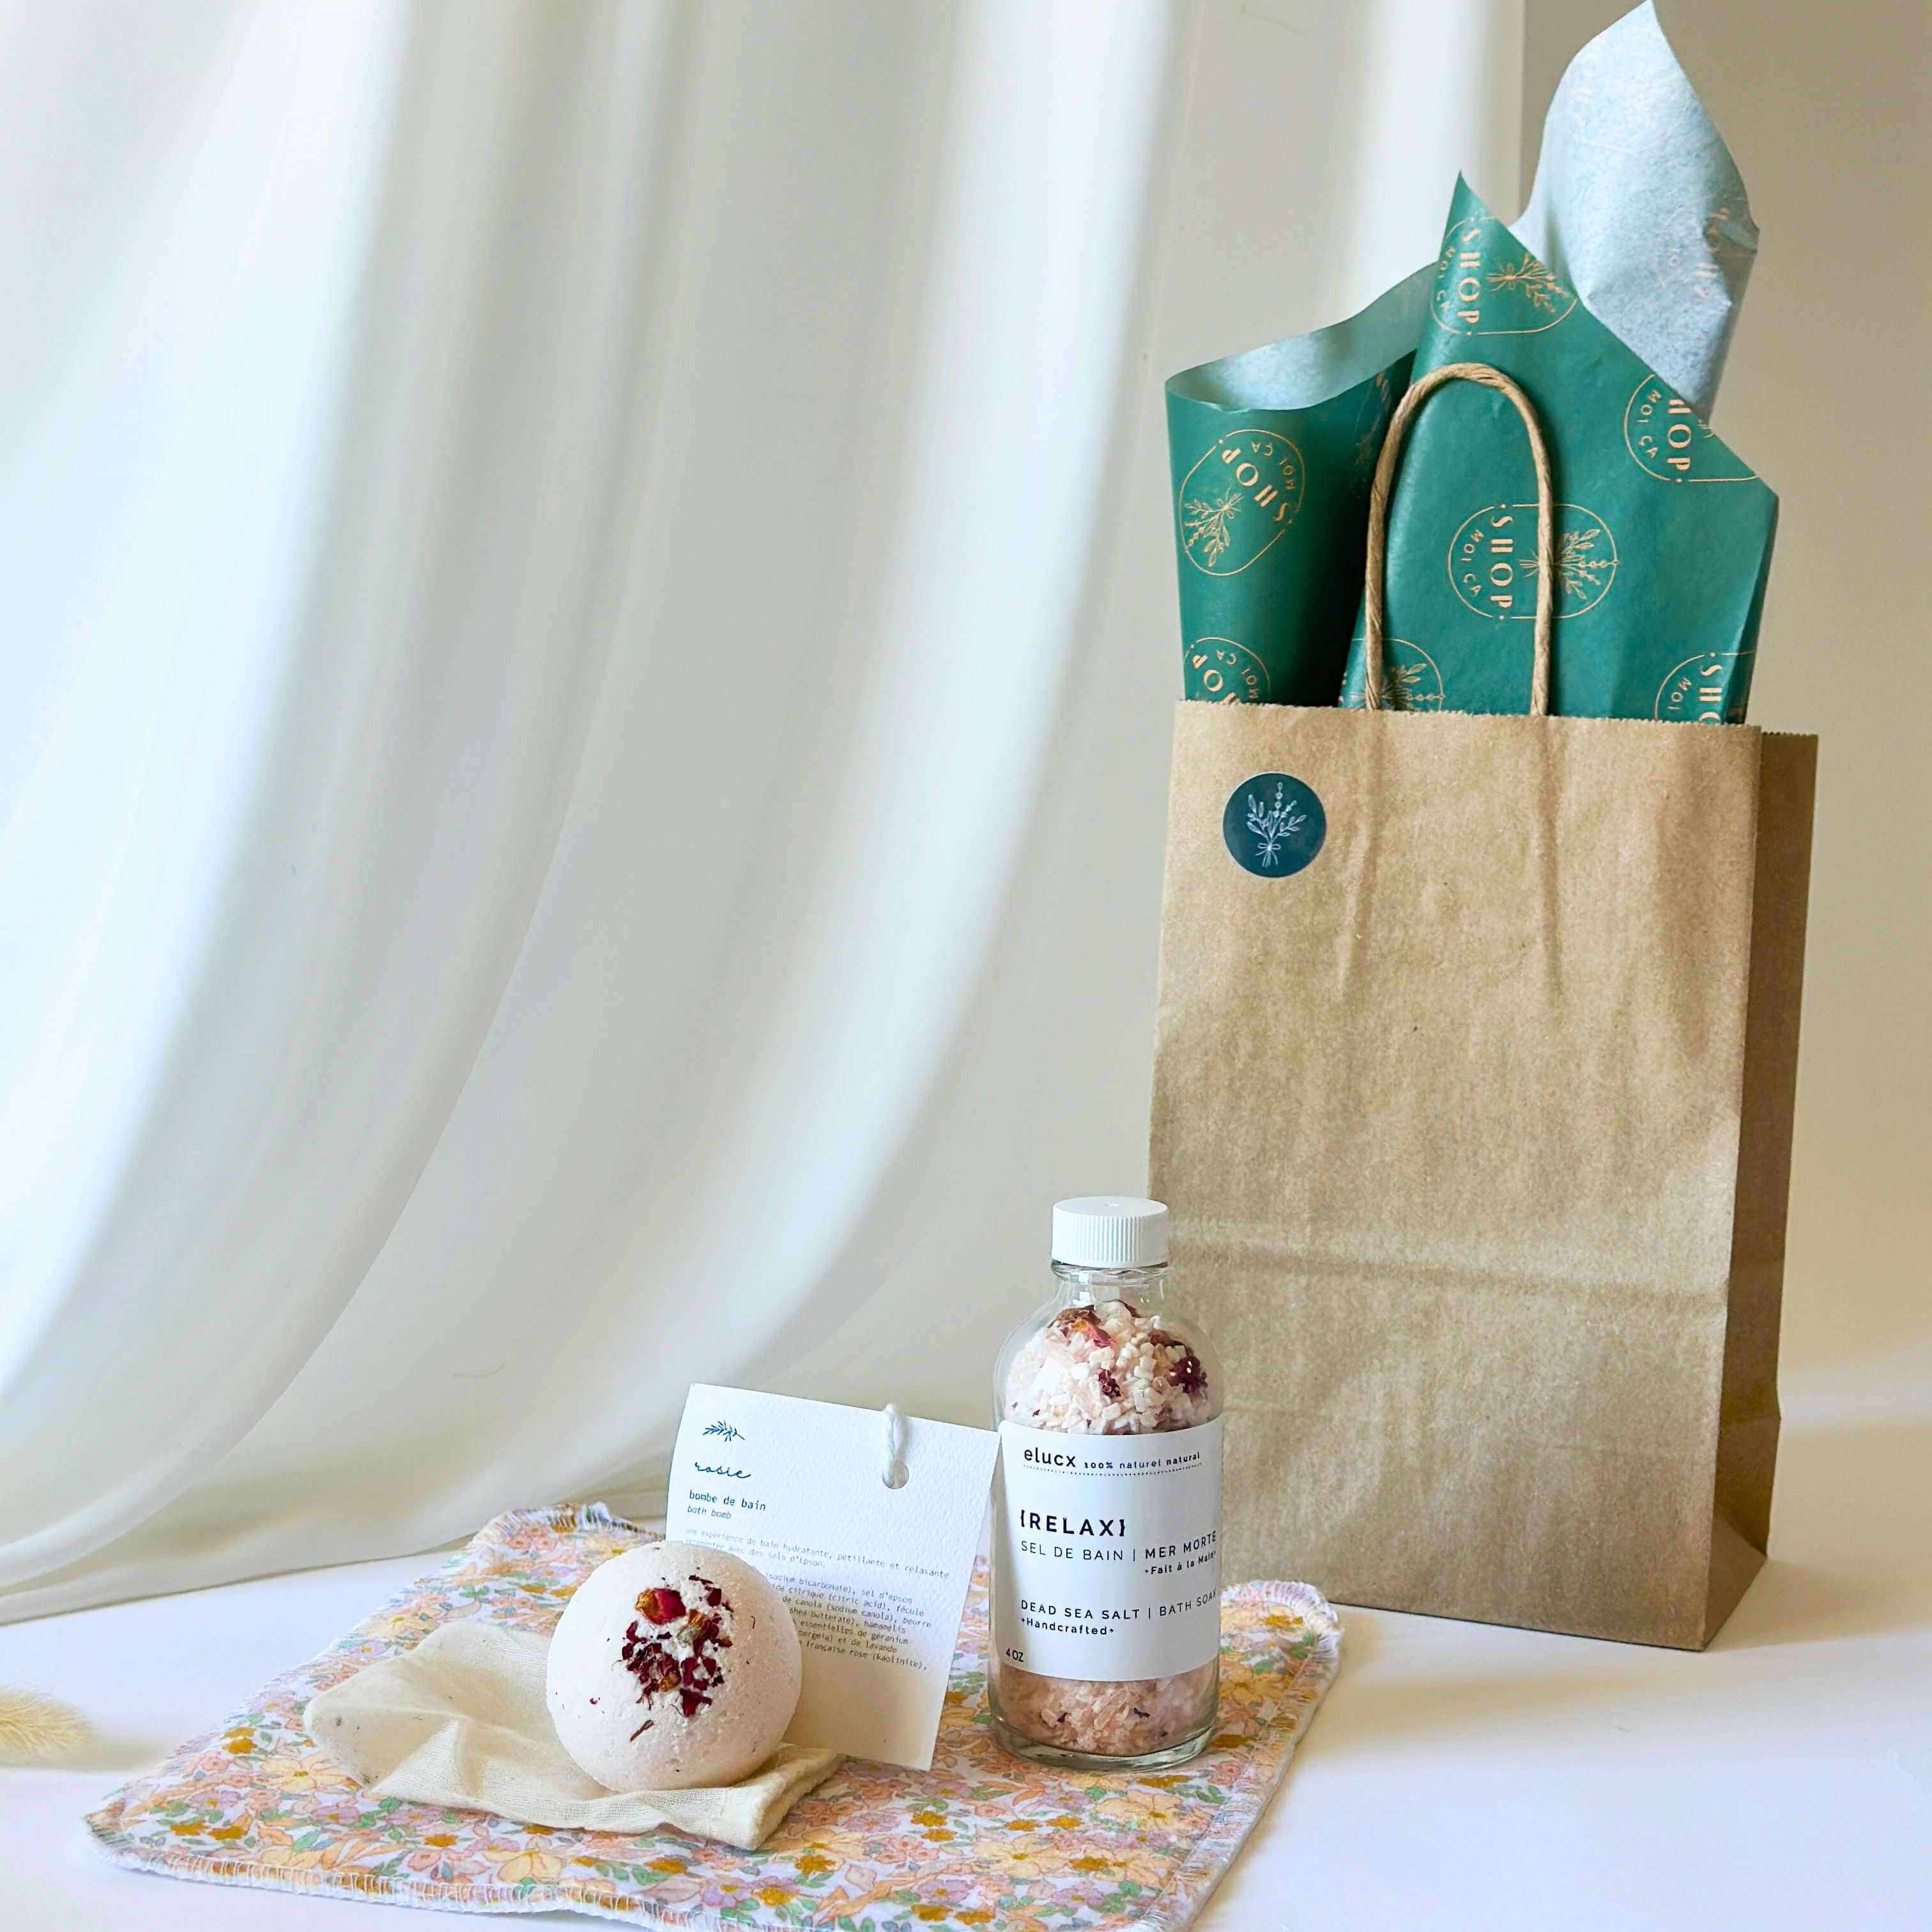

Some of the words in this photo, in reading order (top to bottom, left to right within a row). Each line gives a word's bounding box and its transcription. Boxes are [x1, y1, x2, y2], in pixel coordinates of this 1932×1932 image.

[1459, 229, 1482, 323] SHOP
[1637, 389, 1661, 424] MOI
[1667, 399, 1692, 471] HOP
[1221, 447, 1291, 523] SHOP
[1279, 457, 1296, 491] MOI
[1461, 528, 1485, 562] MOI
[1489, 516, 1514, 608] SHOP
[1241, 667, 1259, 700] MOI
[1667, 677, 1692, 711] MOI
[1023, 1447, 1077, 1468] elucx
[1119, 1458, 1161, 1469] naturel
[1166, 1451, 1200, 1466] natural
[687, 1505, 707, 1515] bath
[711, 1508, 732, 1519] bomb
[689, 1489, 717, 1503] bombe
[723, 1495, 735, 1506] de
[741, 1498, 766, 1512] bain
[1020, 1509, 1126, 1537] {RELAX}
[1021, 1540, 1046, 1556] SEL
[1054, 1546, 1073, 1559] DE
[1083, 1549, 1123, 1560] BAIN
[1145, 1545, 1176, 1560] MER
[905, 1565, 950, 1579] relaxante
[1187, 1560, 1195, 1569] la
[861, 1589, 875, 1597] sel
[795, 1599, 822, 1609] canola
[903, 1616, 931, 1629] beurre
[1021, 1599, 1057, 1615] DEAD
[1064, 1607, 1093, 1620] SEA
[1101, 1609, 1140, 1620] SALT
[1160, 1600, 1192, 1616] BATH
[800, 1621, 854, 1635] essentielles
[849, 1650, 869, 1659] rose
[866, 1640, 898, 1653] lavande
